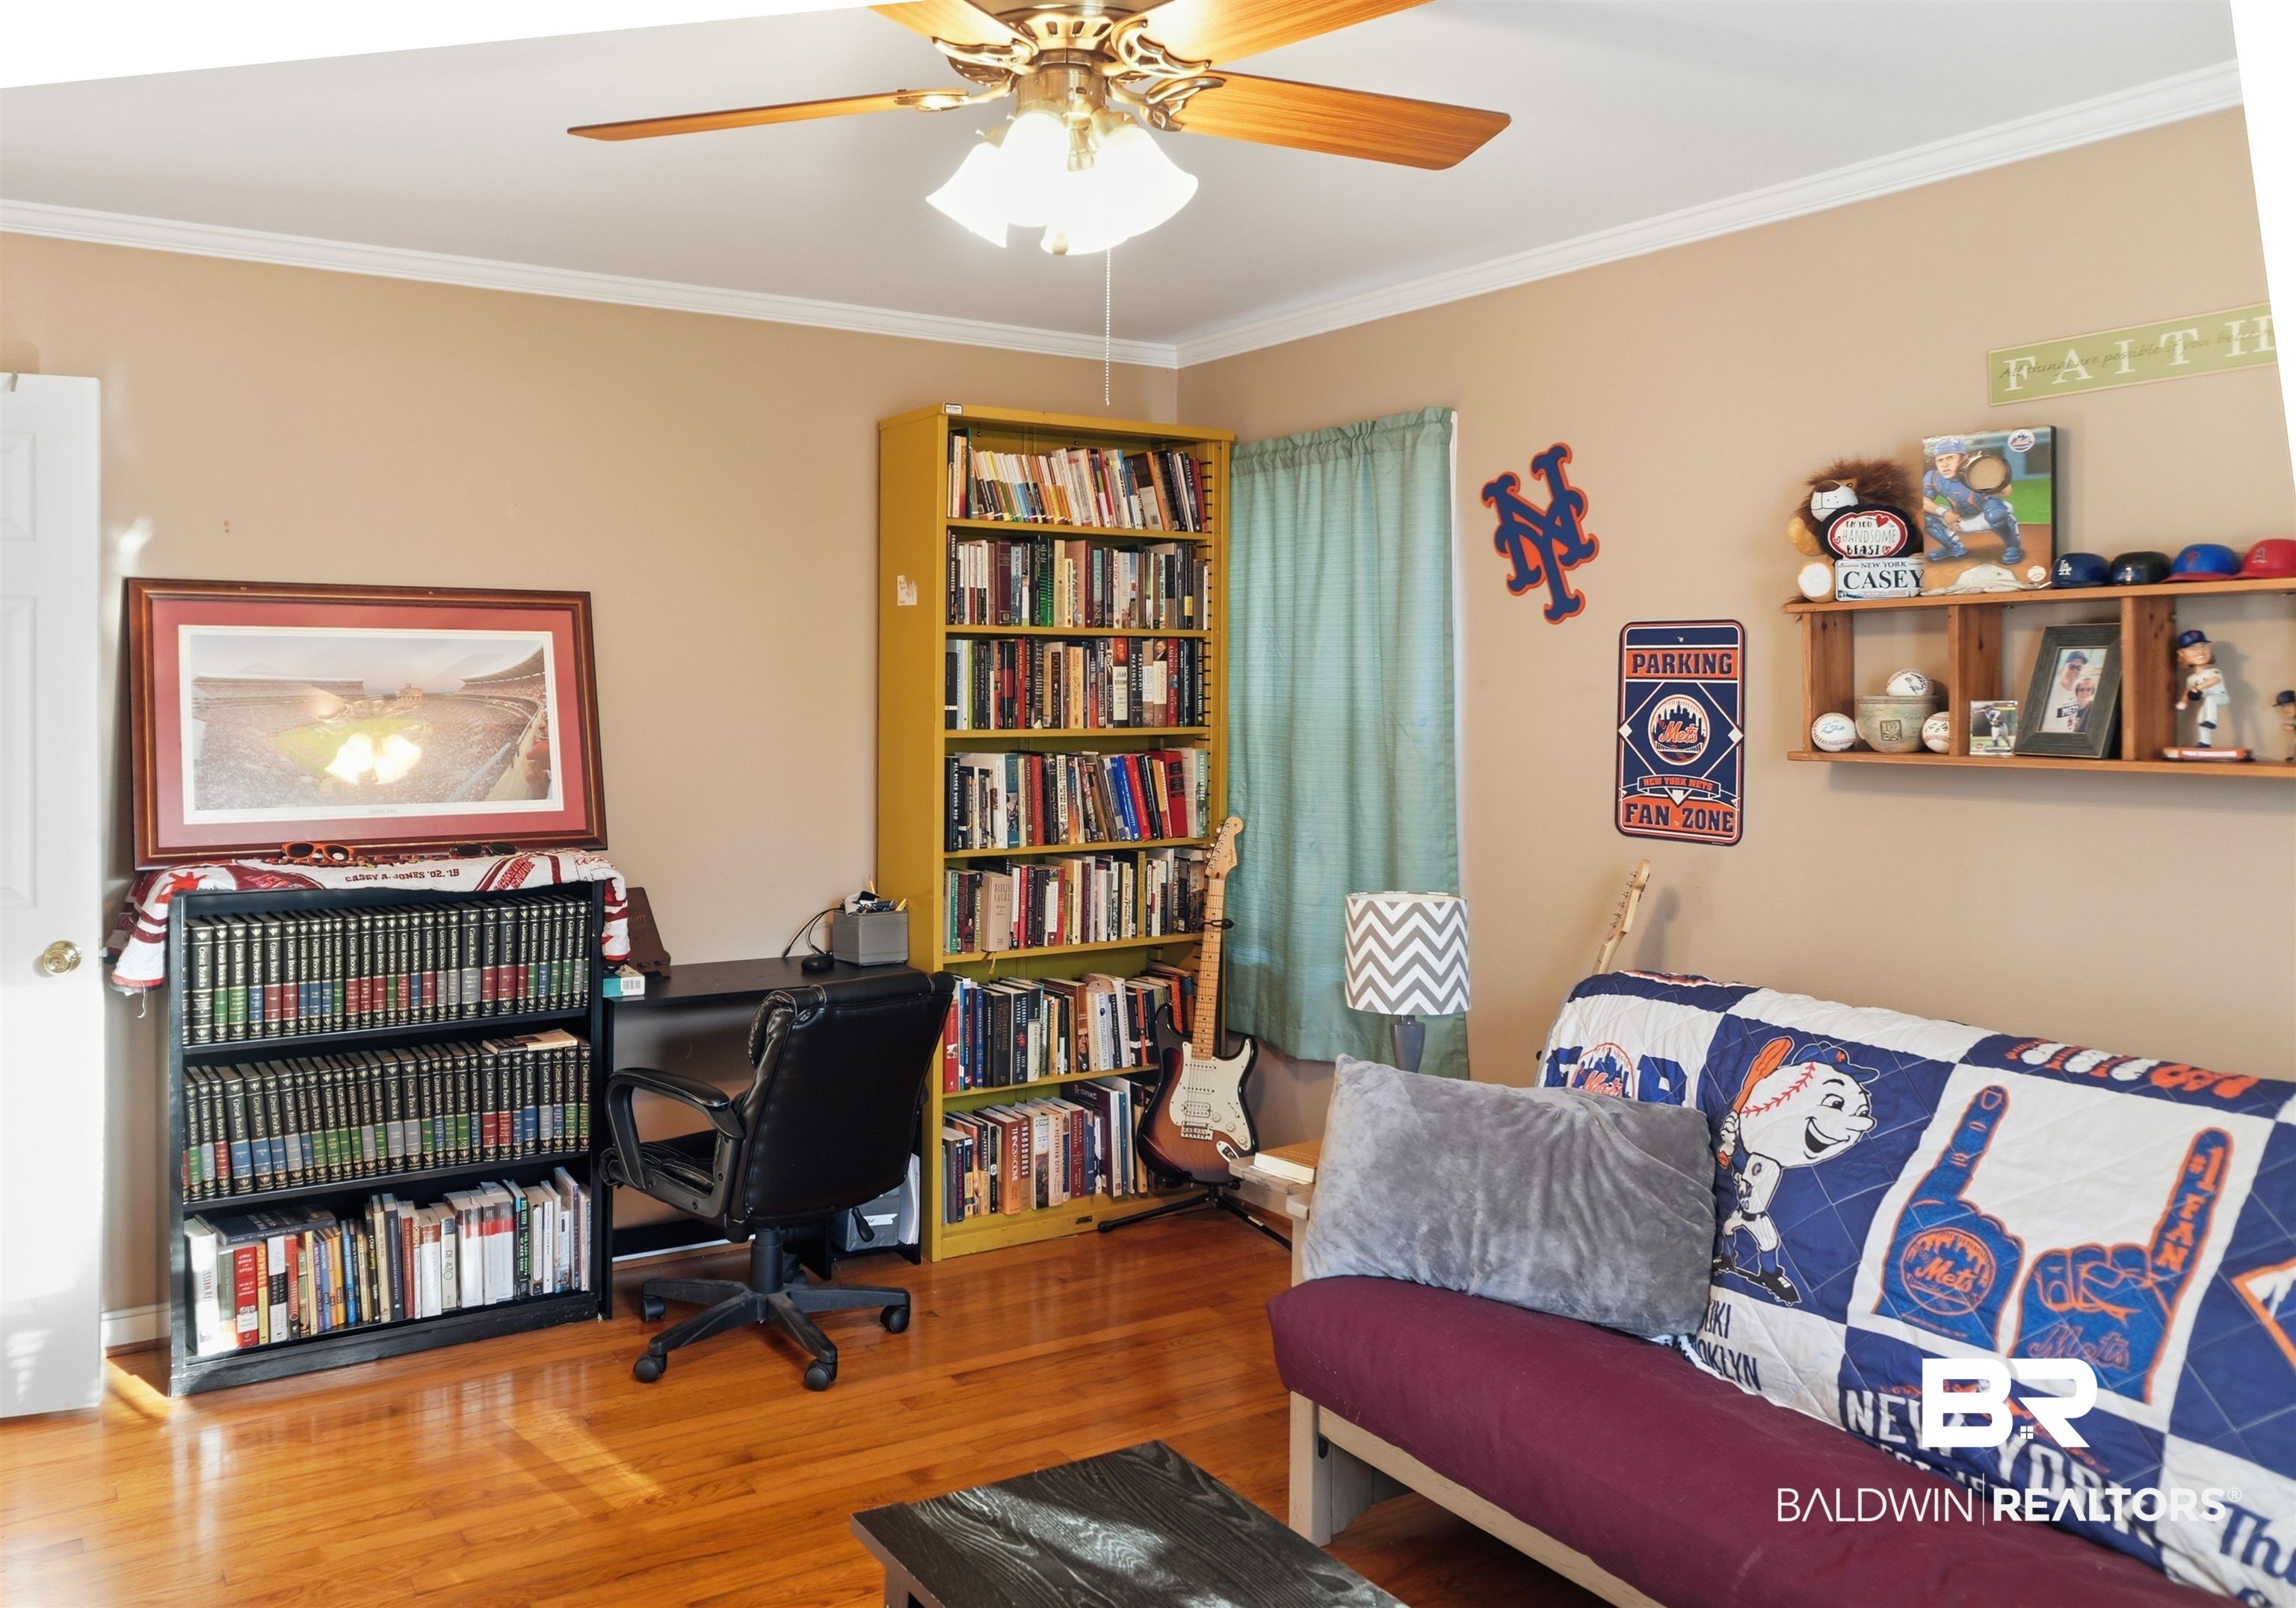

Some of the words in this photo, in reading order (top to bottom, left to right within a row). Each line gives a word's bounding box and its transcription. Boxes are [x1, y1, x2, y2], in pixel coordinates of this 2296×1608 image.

[2003, 315, 2275, 392] FAITH
[1842, 529, 1897, 543] HANDSOME
[1843, 569, 1925, 590] CASEY
[1632, 653, 1733, 674] PARKING
[1658, 721, 1699, 743] Mets
[1642, 777, 1663, 786] NEW
[1664, 777, 1687, 786] YORK
[1688, 778, 1713, 791] METS
[1625, 803, 1670, 826] FAN
[1682, 807, 1734, 832] ZONE
[345, 872, 378, 882] CASEY
[393, 870, 425, 880] JONES
[198, 946, 207, 965] Great
[235, 943, 244, 962] Great
[253, 943, 261, 961] Great
[270, 942, 278, 961] Great
[198, 966, 207, 987] Books
[235, 963, 244, 984] Books
[253, 963, 261, 983] Books
[270, 961, 278, 982] Books
[232, 1099, 241, 1117] Great
[235, 1118, 244, 1139] Books
[255, 1116, 263, 1136] Books
[271, 1114, 280, 1134] Books
[257, 1249, 265, 1288] ORWELL
[1916, 1259, 1973, 1292] Mets
[2028, 1323, 2129, 1371] Mets
